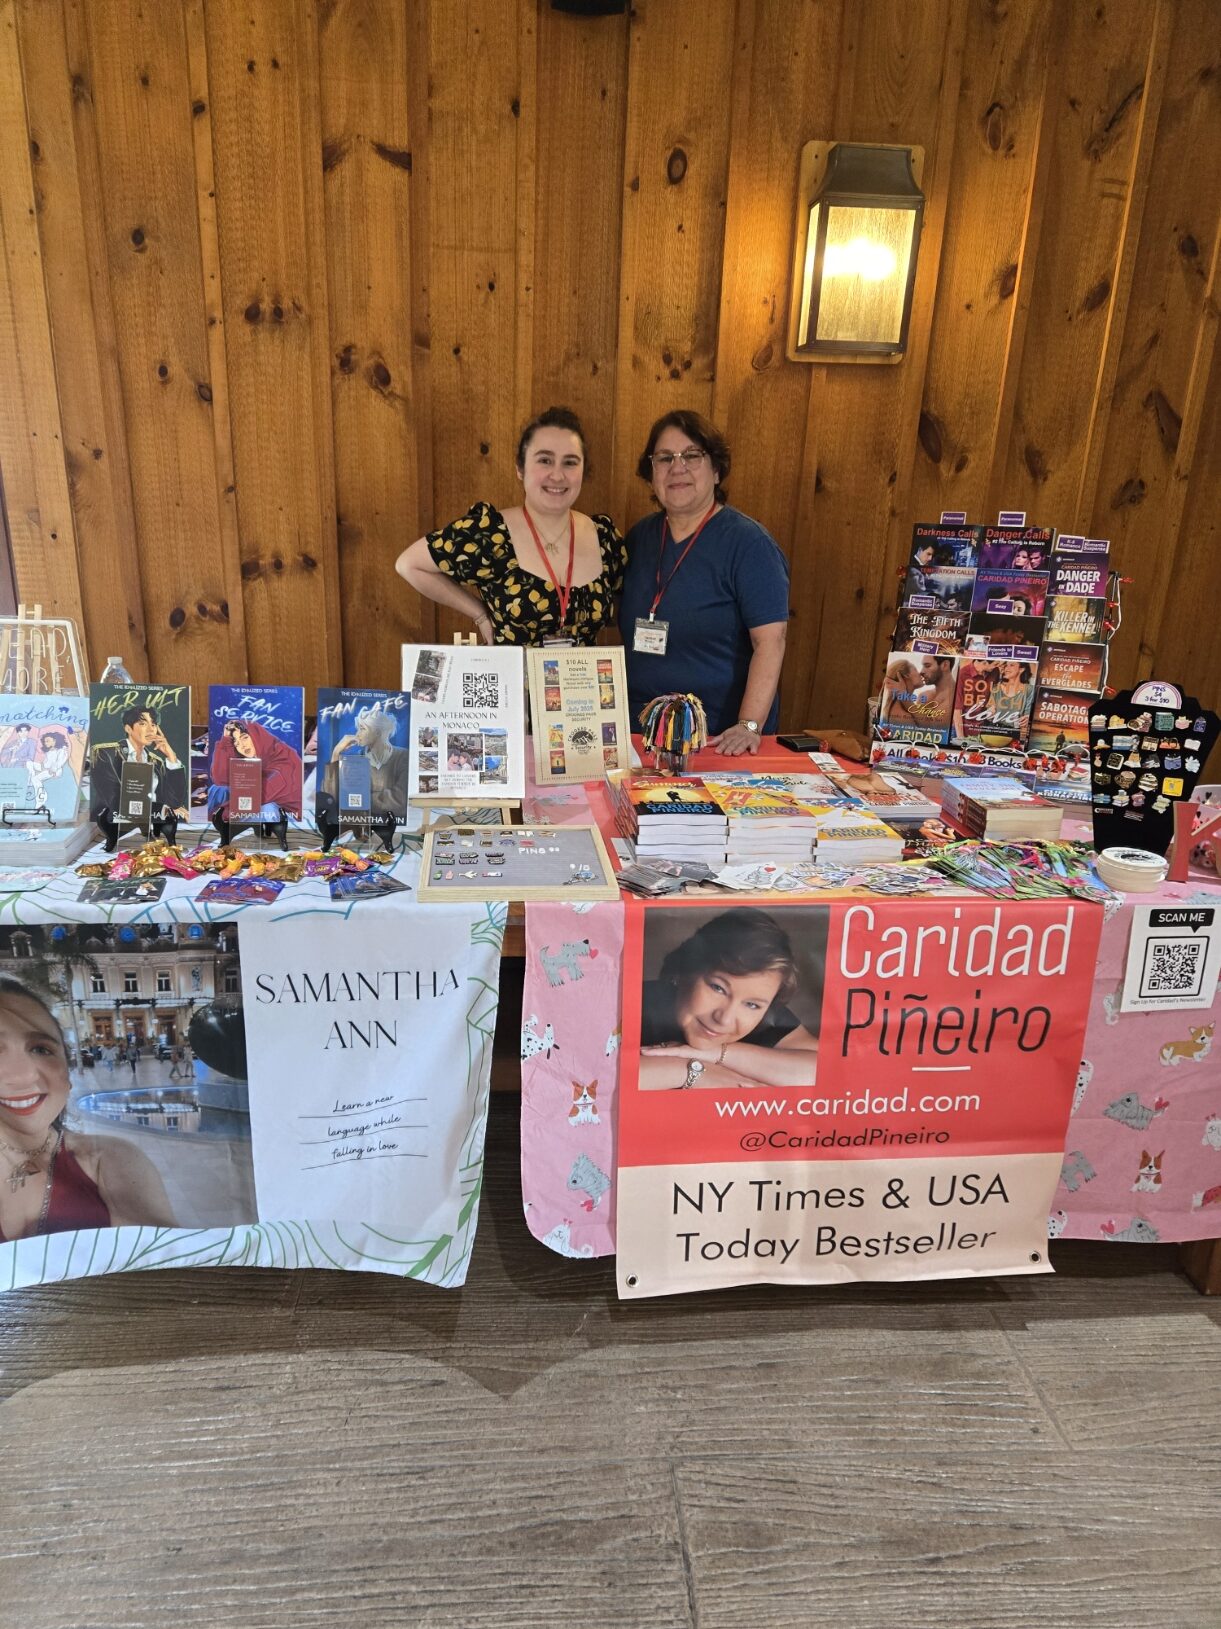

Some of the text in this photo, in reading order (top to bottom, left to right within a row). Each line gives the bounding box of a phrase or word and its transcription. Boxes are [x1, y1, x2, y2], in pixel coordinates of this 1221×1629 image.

[917, 528, 979, 538] Darkness Calls
[986, 528, 1051, 539] Danger Calls
[977, 575, 1013, 583] CARIDAD
[1056, 570, 1101, 582] DANGER
[1066, 582, 1096, 593] DADE
[1054, 611, 1088, 623] KILLER
[1060, 621, 1097, 634] KENNEL
[1054, 664, 1084, 673] ESCAPE
[1041, 677, 1092, 689] EVERGLADES
[891, 688, 917, 702] Take
[90, 691, 139, 720] HER
[237, 695, 281, 714] FAN
[319, 698, 357, 724] FAN
[1041, 702, 1089, 716] SABOTAG
[214, 705, 297, 733] SERVICE
[439, 711, 488, 719] AFTERNOON
[489, 711, 497, 719] IN
[442, 721, 480, 729] MONACO
[893, 730, 942, 743] ARIDAD
[887, 749, 903, 758] All
[987, 756, 1022, 769] Books
[230, 811, 277, 819] SAMANTHA
[338, 815, 384, 824] SAMANTHA
[1158, 913, 1206, 922] SCAN ME
[840, 905, 1075, 979] Caridad
[255, 968, 460, 1004] SAMANTHA
[841, 988, 1051, 1057] Piñeiro
[323, 1020, 397, 1050] ANN
[332, 1100, 364, 1113] Learn
[374, 1096, 394, 1105] new
[714, 1087, 981, 1118] www.caridad.com
[327, 1114, 401, 1139] language while
[739, 1128, 950, 1152] @CaridadPineiro
[331, 1147, 365, 1160] falling
[378, 1140, 398, 1151] love
[672, 1173, 1009, 1215] NY Times & USA
[676, 1222, 997, 1264] Today Bestseller
